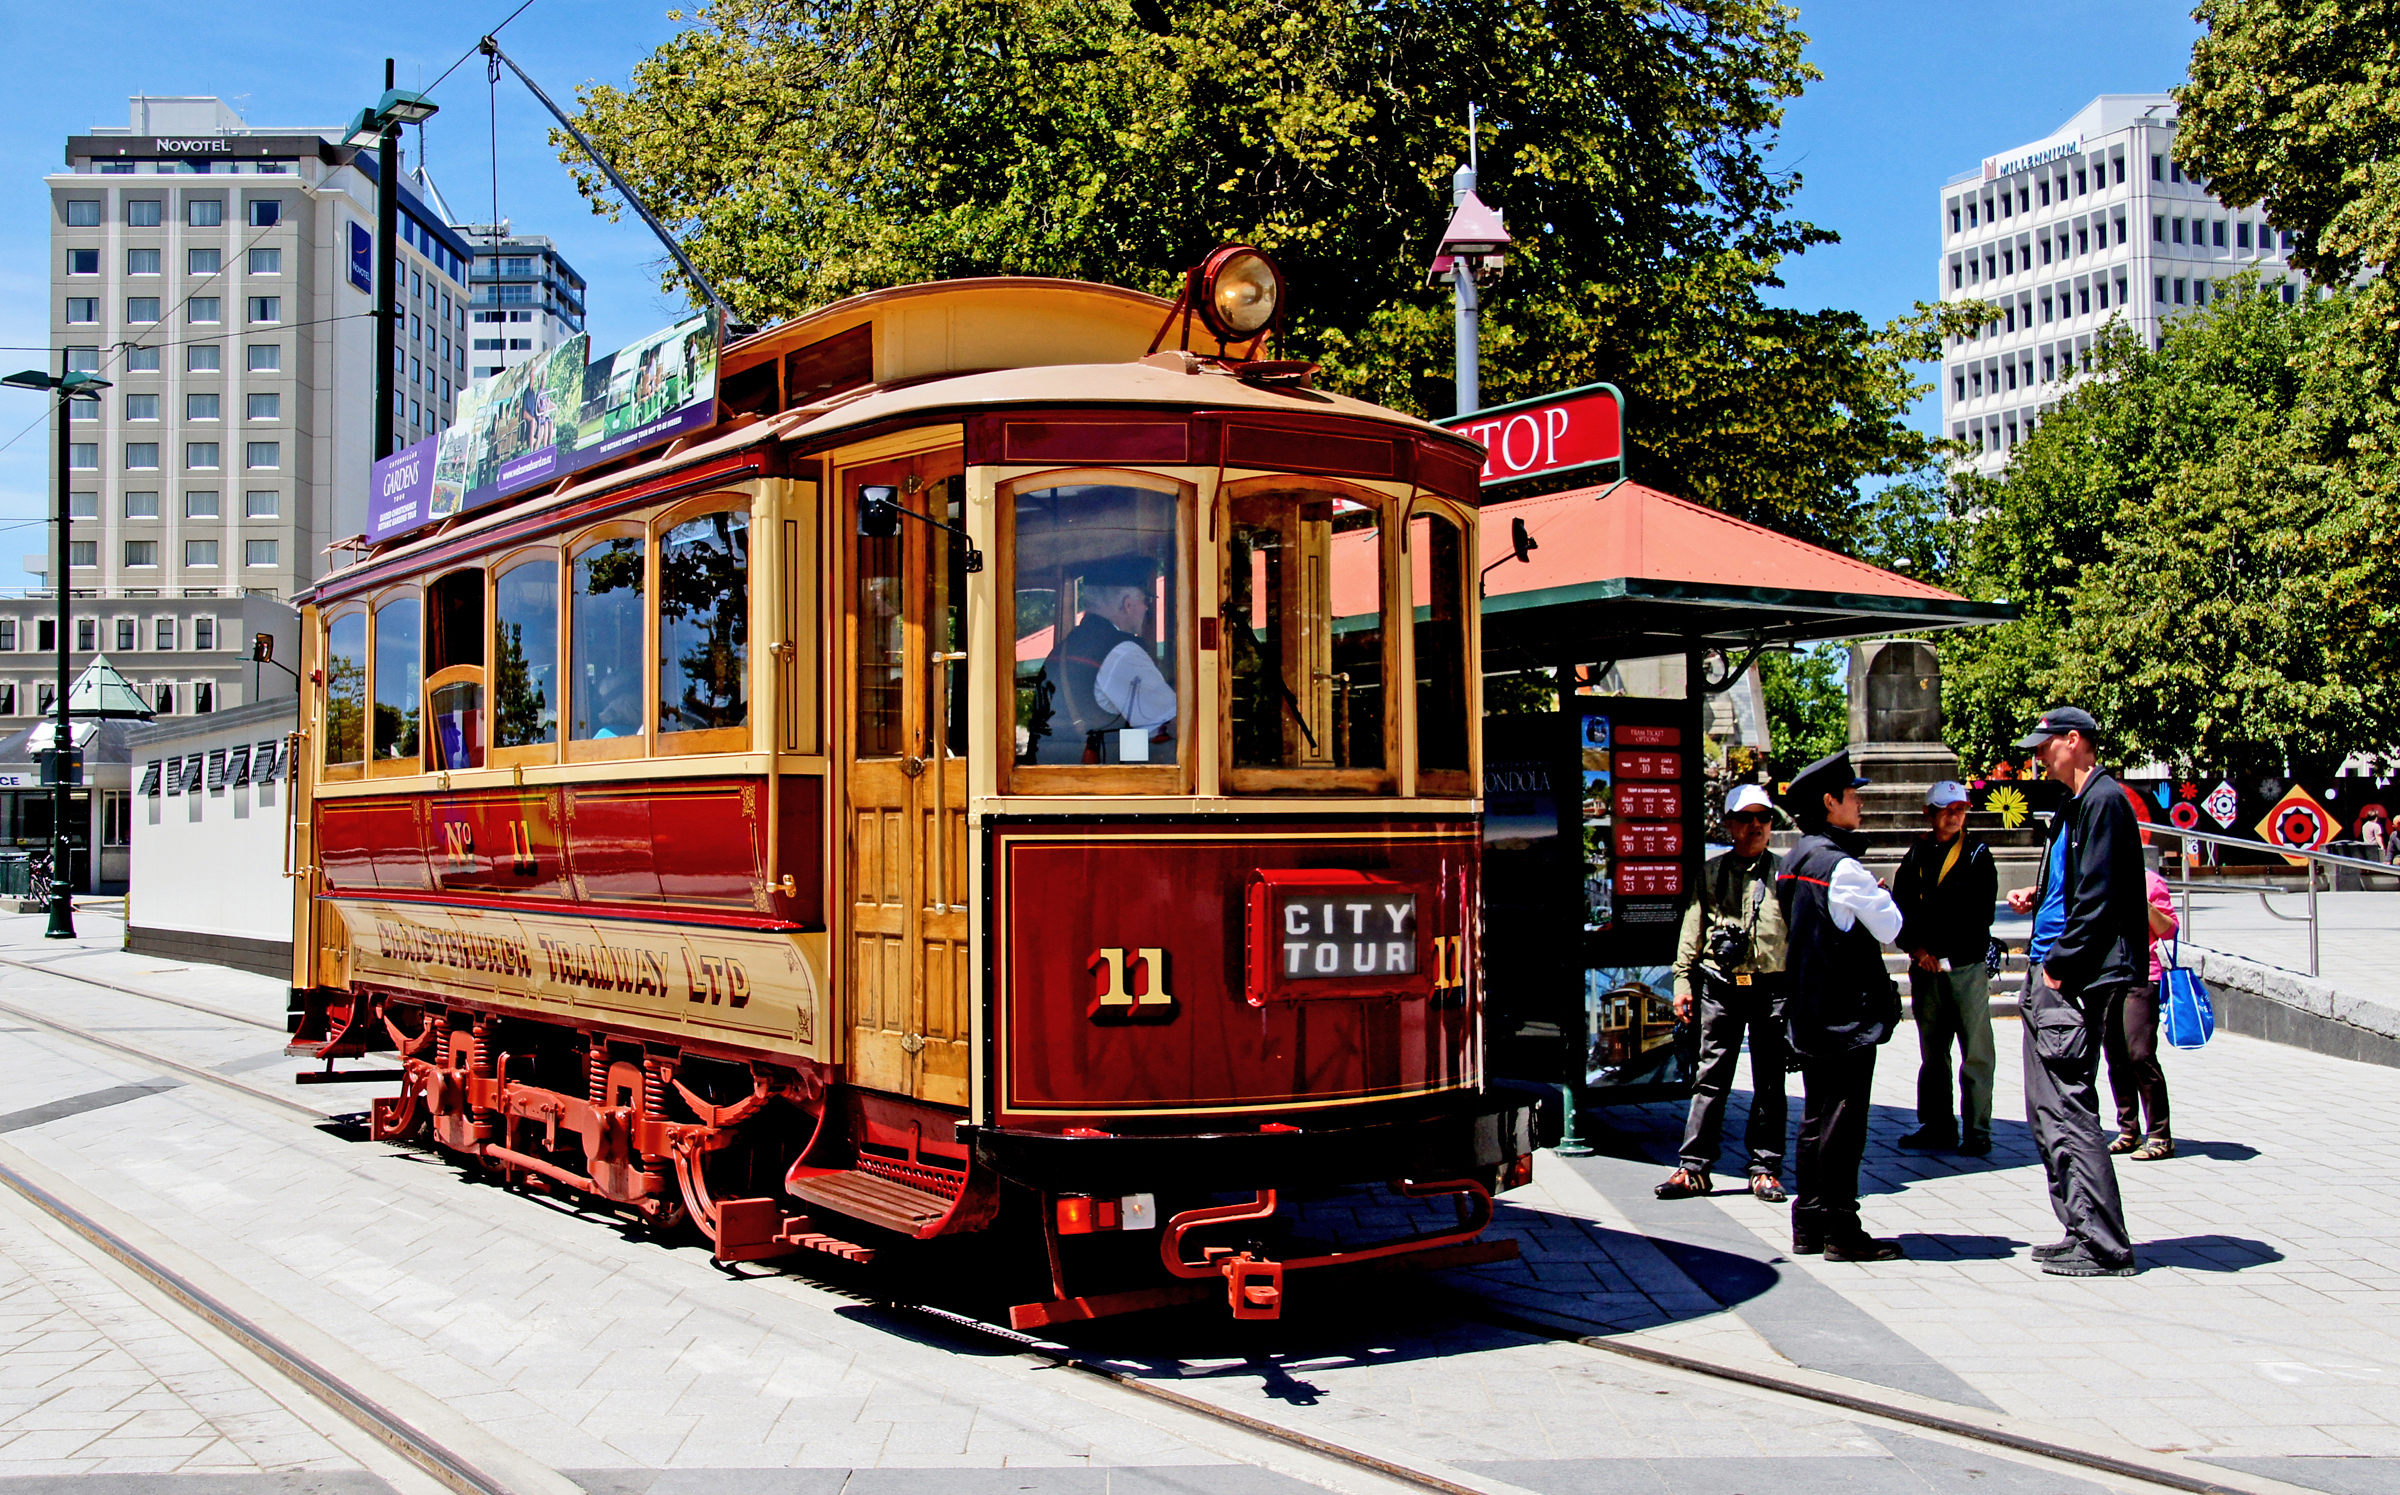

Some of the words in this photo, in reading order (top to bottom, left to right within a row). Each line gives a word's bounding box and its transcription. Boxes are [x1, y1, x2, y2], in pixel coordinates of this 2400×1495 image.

[156, 138, 232, 152] NOVOTEL
[2000, 141, 2077, 176] MILLENNIUM
[352, 260, 371, 282] NOVOTEL
[383, 460, 420, 497] GARDENS
[1484, 771, 1551, 793] ONDOLA
[508, 820, 536, 862] 11
[1284, 904, 1411, 935] CITY
[375, 917, 533, 978] CHRISTCHURCH
[538, 932, 669, 998] TRAMWAY
[681, 946, 751, 1008] LTD
[1093, 947, 1174, 1013] 11
[1434, 934, 1464, 990] 11
[1283, 942, 1407, 973] TOUR
